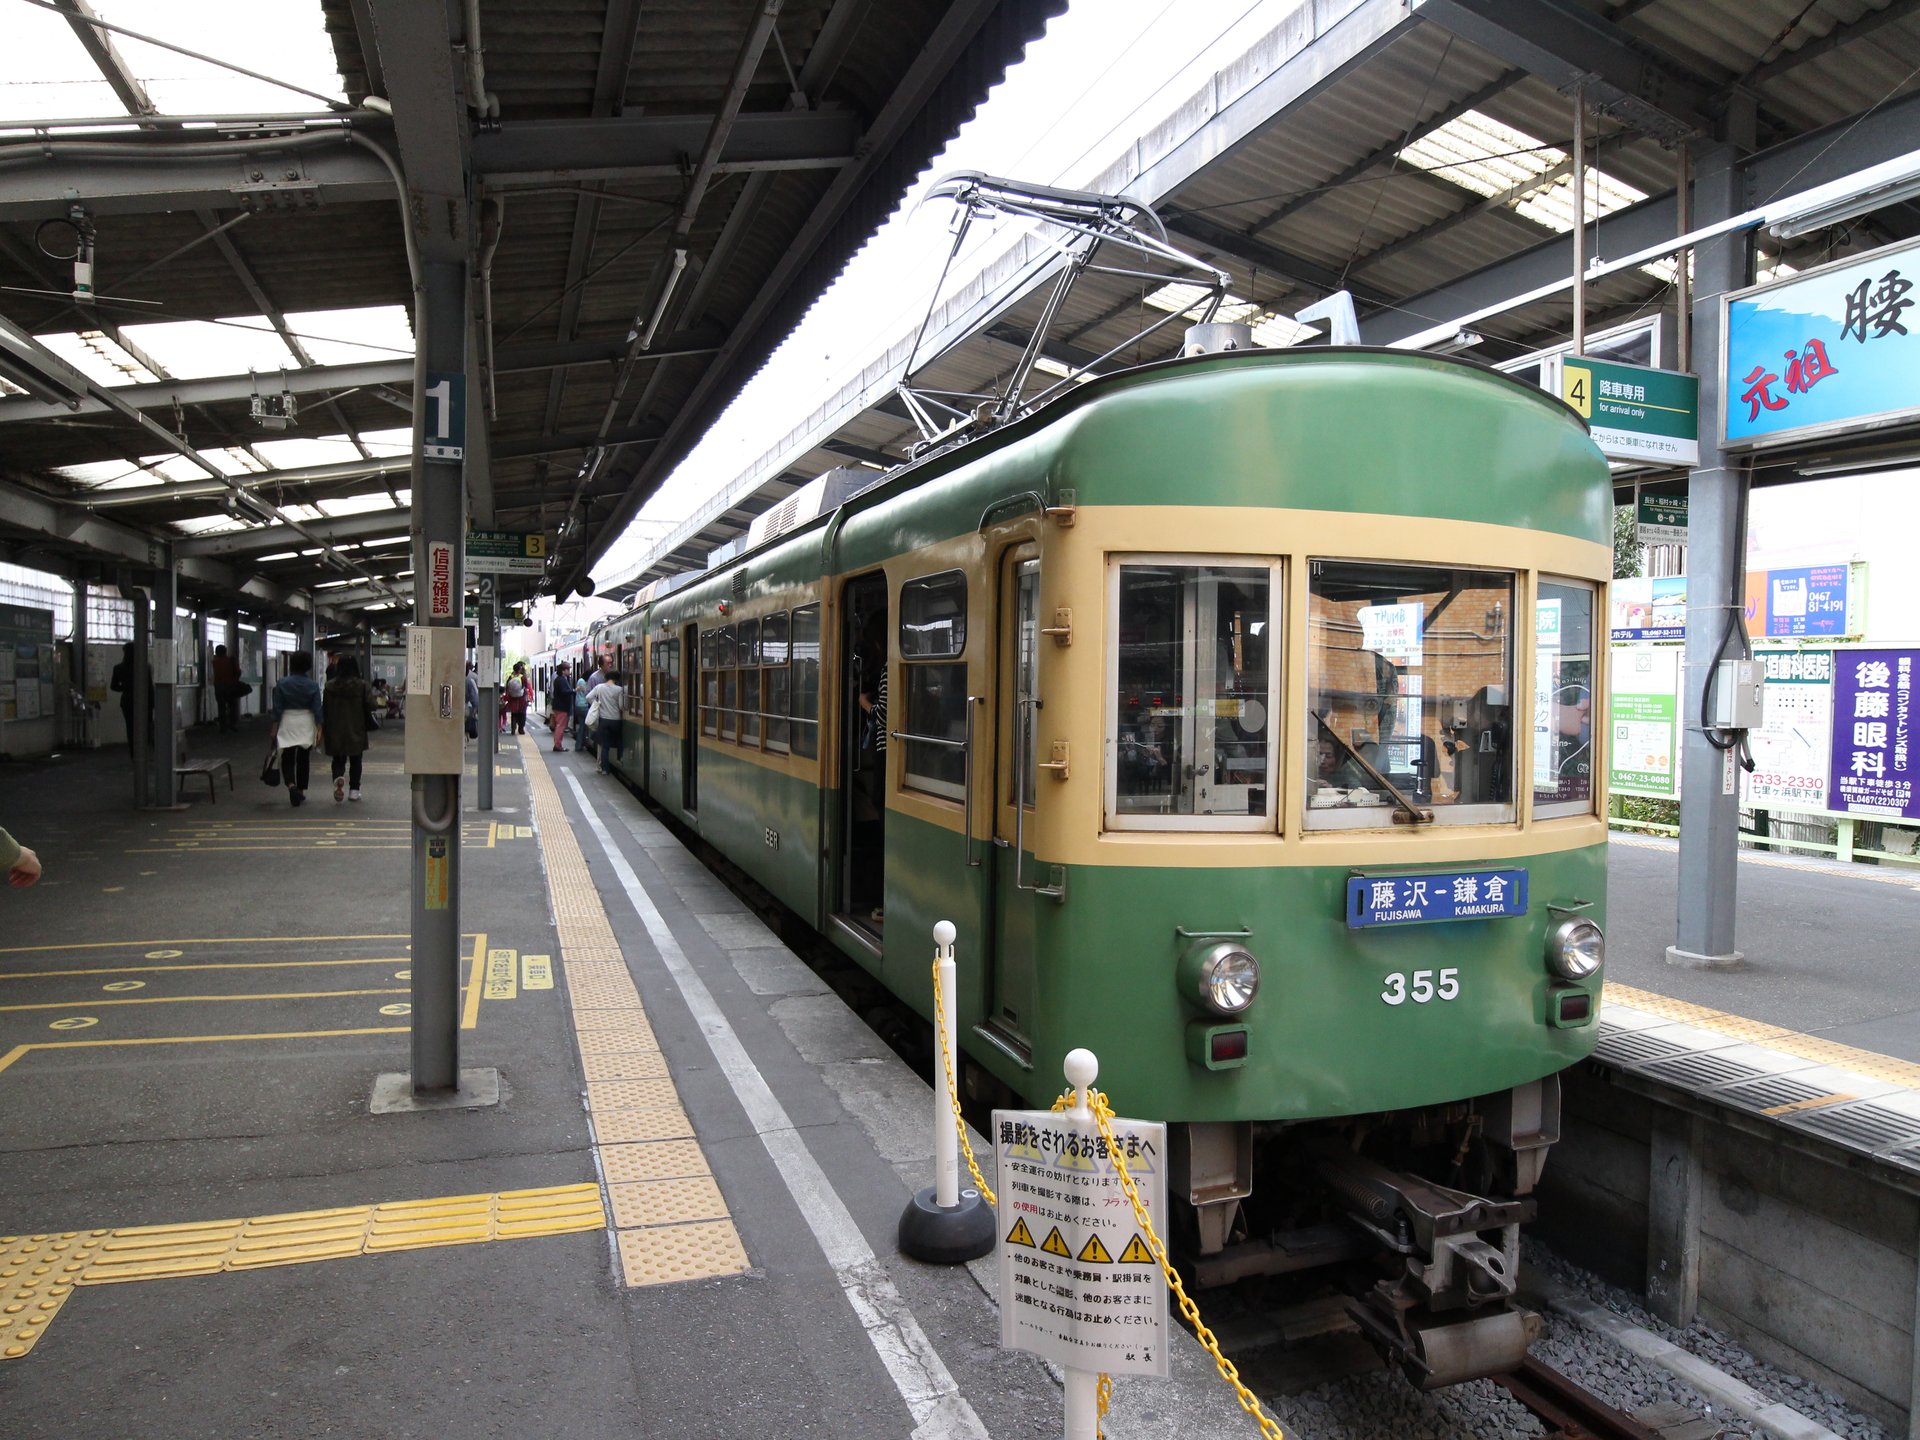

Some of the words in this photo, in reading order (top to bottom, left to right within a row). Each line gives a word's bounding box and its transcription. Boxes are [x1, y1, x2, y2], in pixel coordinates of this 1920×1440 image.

[1840, 269, 1916, 344] 腰
[1599, 379, 1645, 402] 降車専用
[1741, 338, 1839, 423] 元祖
[1570, 378, 1586, 407] 4
[425, 380, 450, 439] 1
[1599, 402, 1609, 412] for
[1610, 404, 1630, 415] arrival
[1631, 407, 1646, 420] only
[530, 537, 540, 554] 3
[432, 547, 450, 614] 信号確認
[480, 578, 492, 598] 2
[1808, 592, 1831, 601] 0467
[1808, 600, 1843, 612] 81-4191
[1536, 610, 1556, 630] 院
[1850, 660, 1891, 779] 後藤眼科
[1618, 772, 1670, 784] 0467-23-0080
[1764, 774, 1824, 789] 33-2330
[1374, 908, 1422, 922] FUJISAWA
[1454, 903, 1505, 916] KAMAKURA
[1380, 967, 1460, 1006] 355
[1011, 1181, 1150, 1208] 列車を撮影する際は、フラッュ
